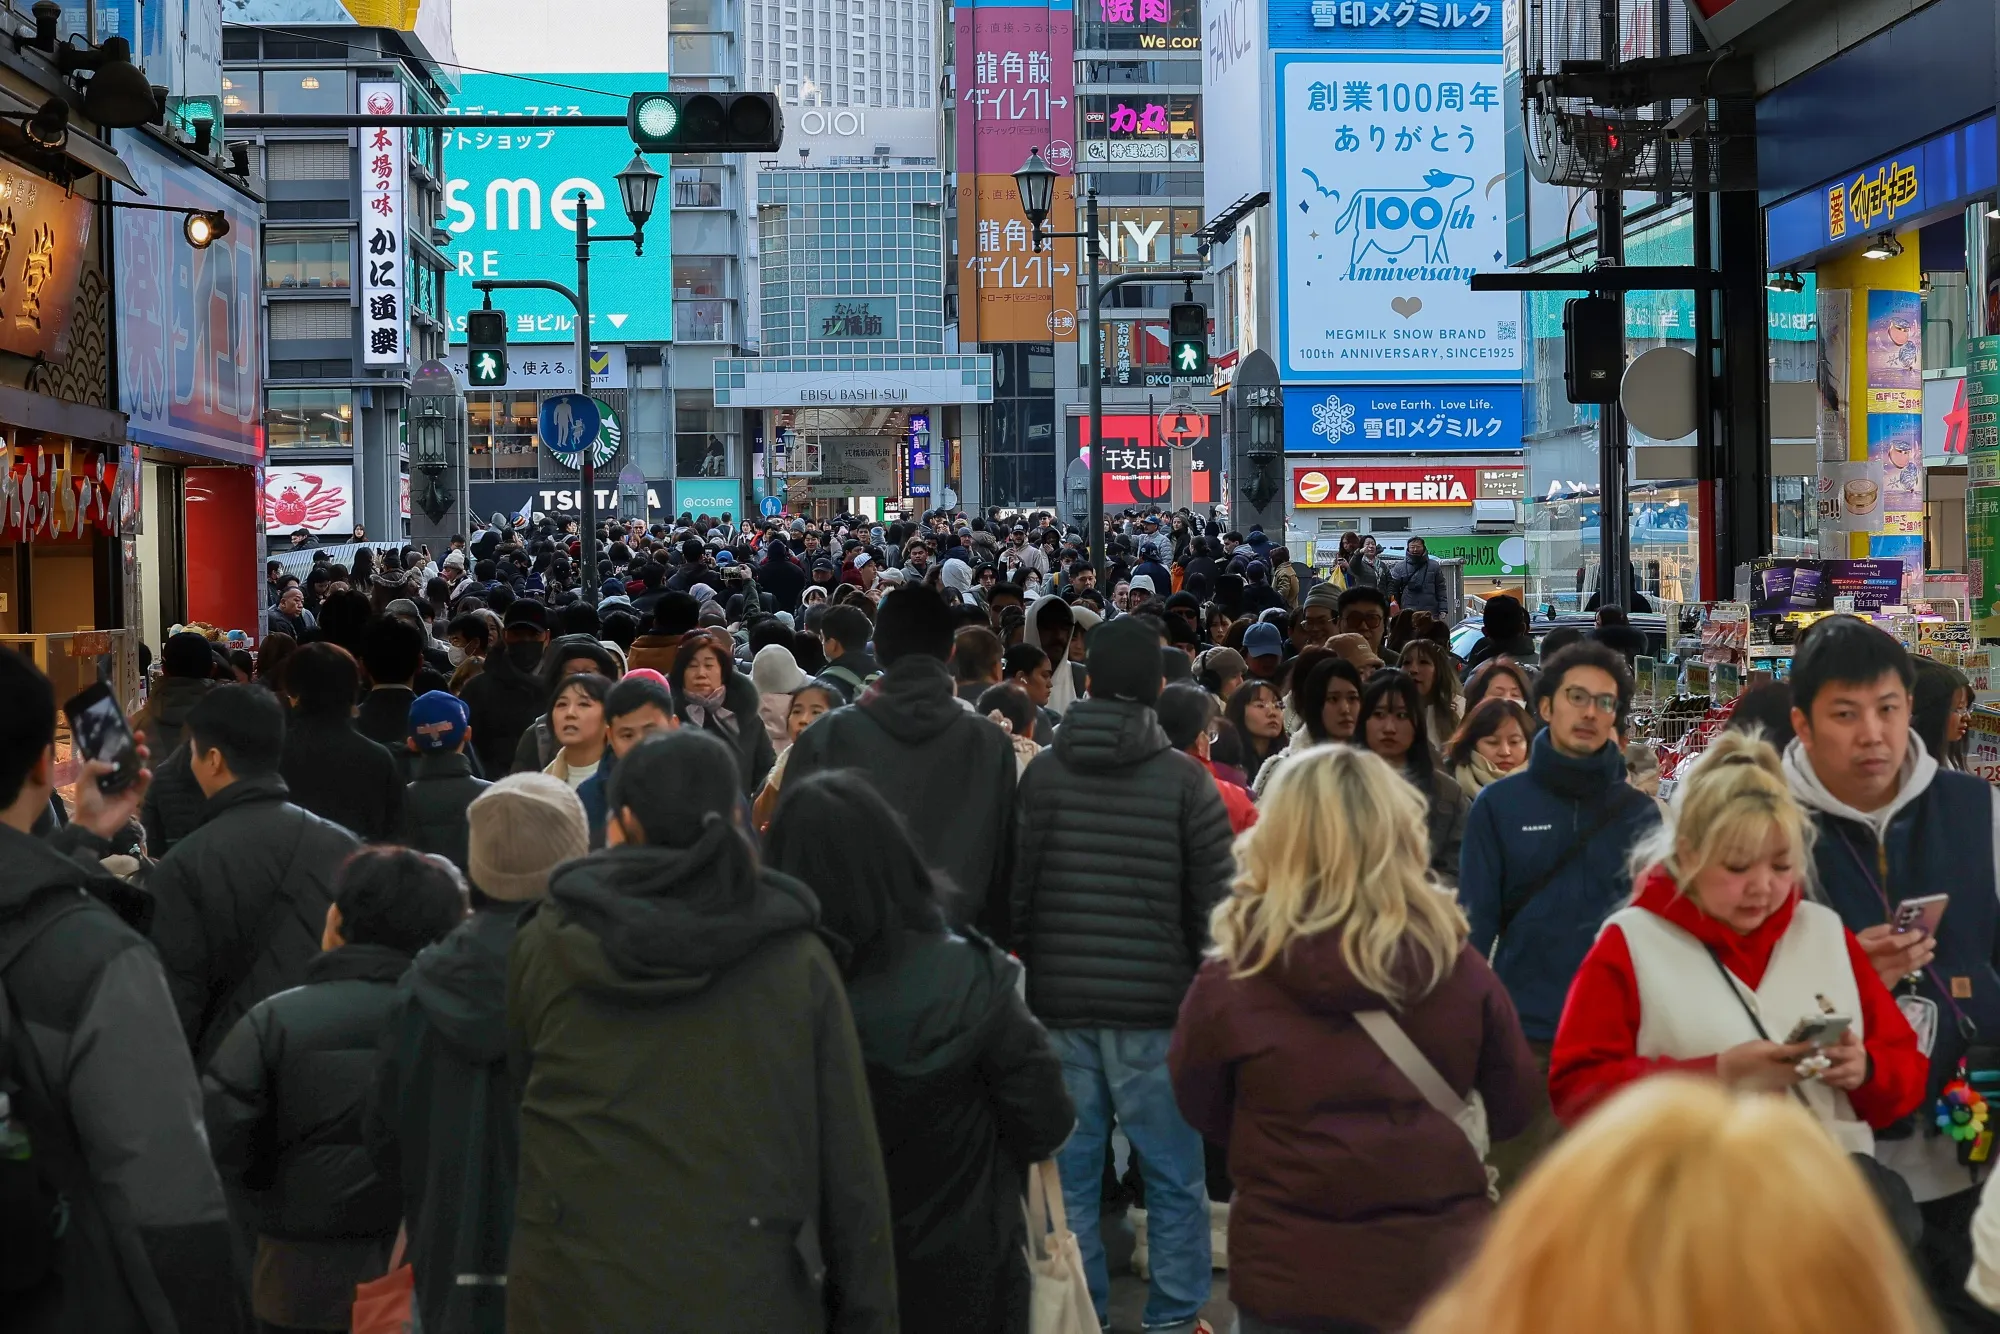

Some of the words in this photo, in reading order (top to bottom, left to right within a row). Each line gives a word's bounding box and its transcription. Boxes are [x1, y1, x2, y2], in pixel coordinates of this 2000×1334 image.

[1100, 0, 1172, 23] 焼肉
[1311, 0, 1491, 28] 雪印メグミルク
[976, 50, 1053, 85] 龍角散
[1307, 80, 1500, 113] 創業100周年
[1086, 113, 1105, 122] OPEN
[1109, 103, 1168, 133] 力丸
[1334, 124, 1476, 153] ありがとう
[1830, 188, 1844, 235] 薬
[1339, 262, 1477, 286] Anniversary
[834, 301, 870, 315] なんば
[821, 315, 883, 337] 戎橋筋
[1325, 329, 1387, 340] MEGMILK
[1393, 328, 1433, 340] SNOW
[1439, 328, 1487, 340] BRAND
[1116, 321, 1130, 384] お好み焼き
[1299, 347, 1334, 359] 100th
[800, 388, 837, 401] EBISU
[840, 387, 908, 400] BASHI-SUJI
[1371, 399, 1397, 410] Love
[1400, 399, 1436, 410] Earth.
[1440, 399, 1466, 410] Love
[1469, 398, 1494, 410] Life.
[1363, 413, 1503, 439] 雪印メグミルク
[1336, 477, 1468, 501] ZETTERIA
[1497, 488, 1525, 496] コーヒー
[683, 497, 734, 508] @cosme
